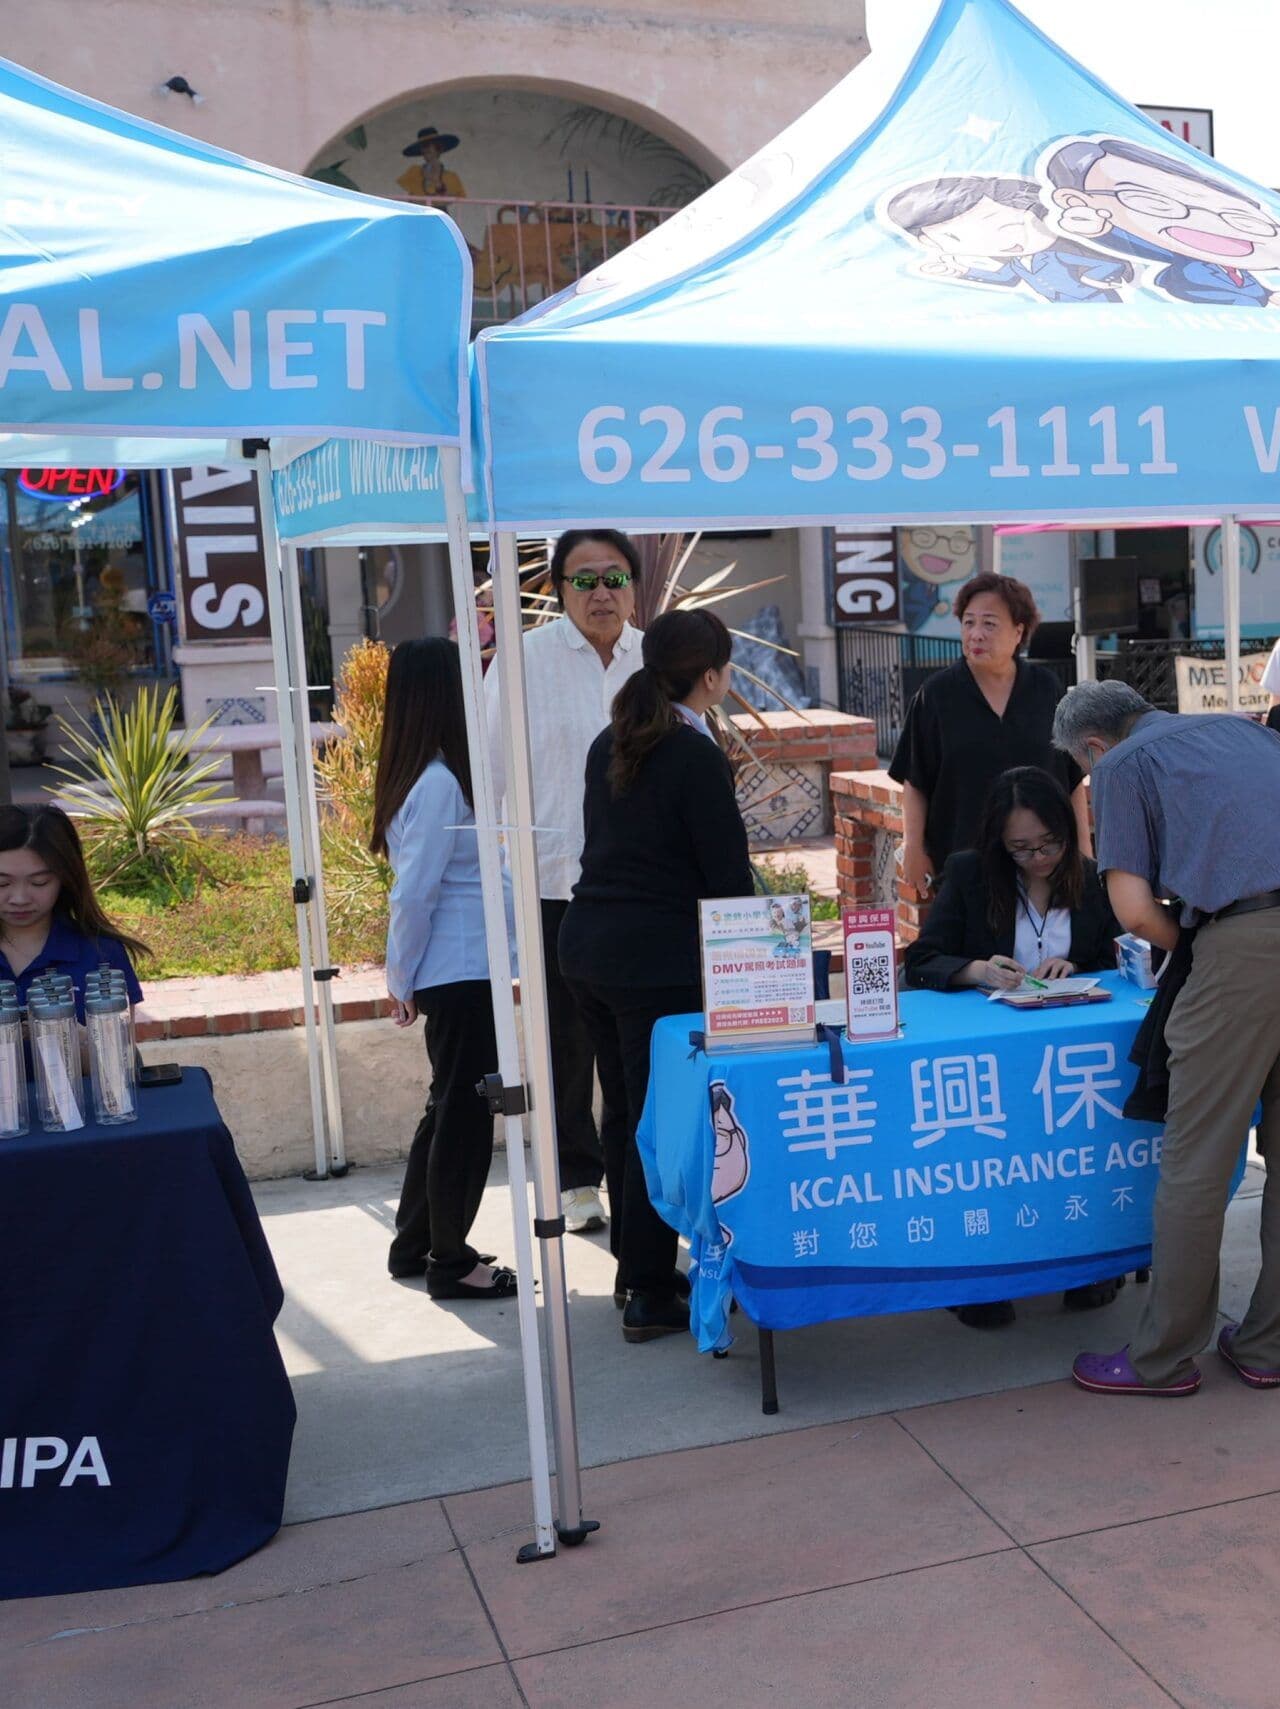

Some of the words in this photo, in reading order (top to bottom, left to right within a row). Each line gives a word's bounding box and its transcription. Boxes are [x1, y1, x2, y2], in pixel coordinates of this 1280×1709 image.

[578, 404, 1178, 485] 626-333-1111
[777, 1042, 1124, 1161] 華興保
[790, 1172, 883, 1212] KCAL
[893, 1145, 1096, 1199] INSURANCE
[0, 1436, 111, 1488] IPA
